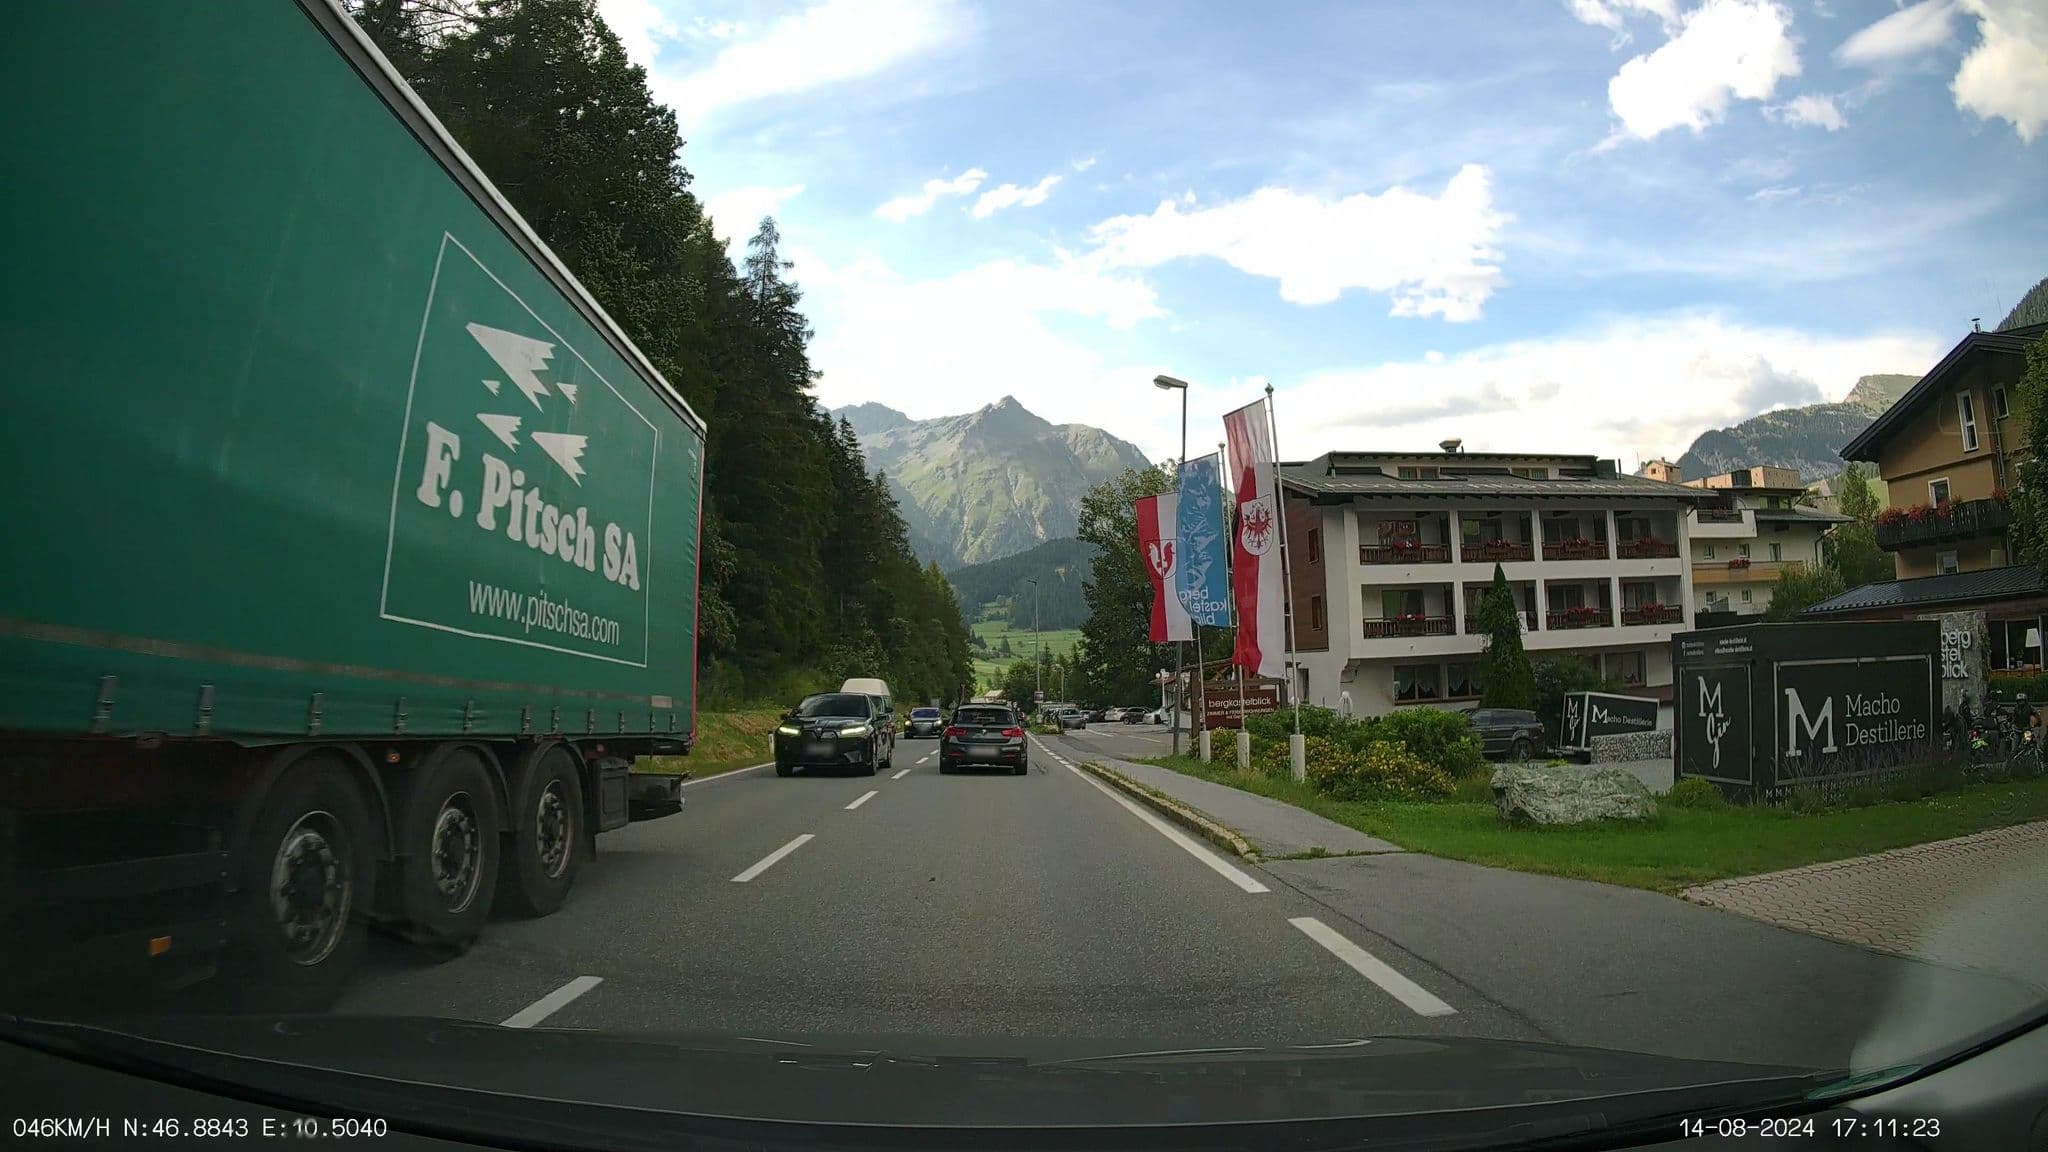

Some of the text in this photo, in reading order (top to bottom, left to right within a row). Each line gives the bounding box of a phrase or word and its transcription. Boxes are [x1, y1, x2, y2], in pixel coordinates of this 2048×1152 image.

[416, 421, 640, 591] F. Pitsch SA
[469, 580, 620, 646] www.pitschsa.com
[1697, 675, 1724, 718] M
[1785, 687, 1839, 758] M
[1845, 692, 1900, 718] Macho
[1845, 719, 1926, 747] Destillerie
